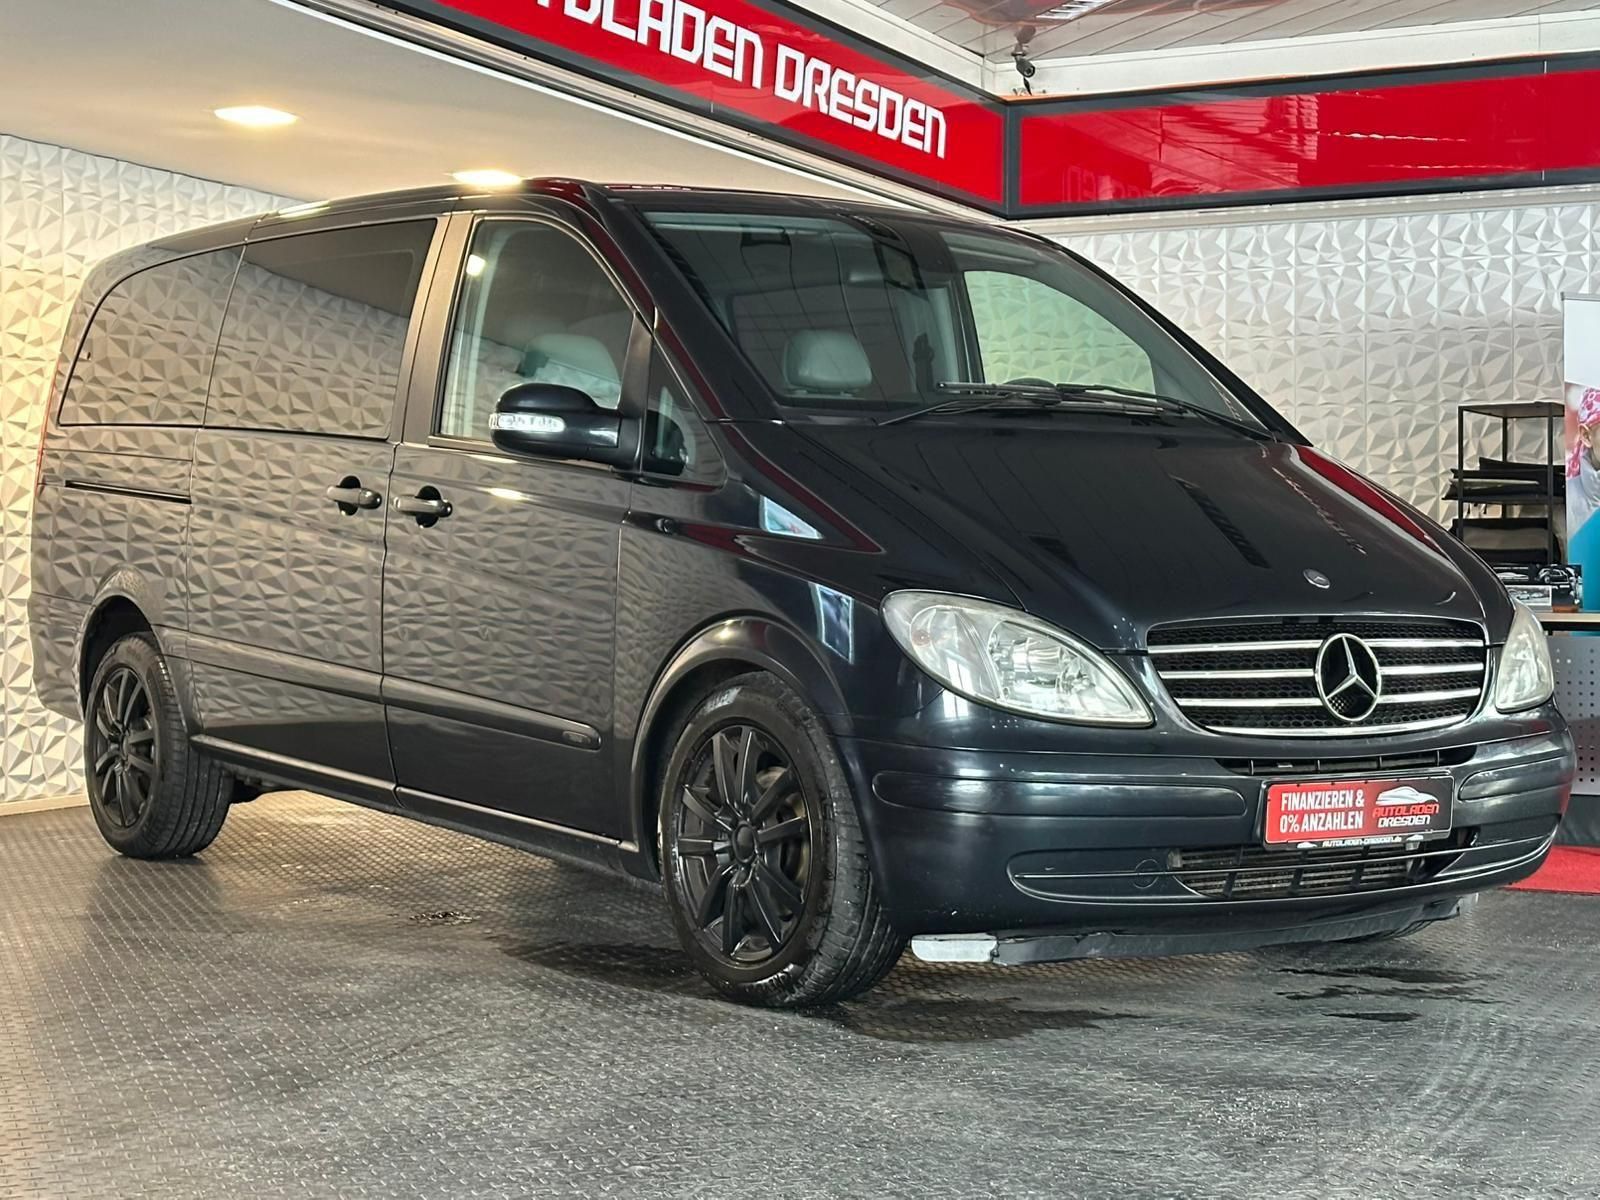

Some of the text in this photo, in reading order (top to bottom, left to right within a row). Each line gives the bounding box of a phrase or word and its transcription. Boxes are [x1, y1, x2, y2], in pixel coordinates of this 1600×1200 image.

[537, 0, 947, 159] LADEN DRESDEN
[1281, 789, 1365, 811] FINANZIEREN &
[1372, 803, 1440, 818] AUTOLADEN
[1279, 811, 1364, 833] 0% ANZAHLEN
[1377, 815, 1431, 828] DRESDEN
